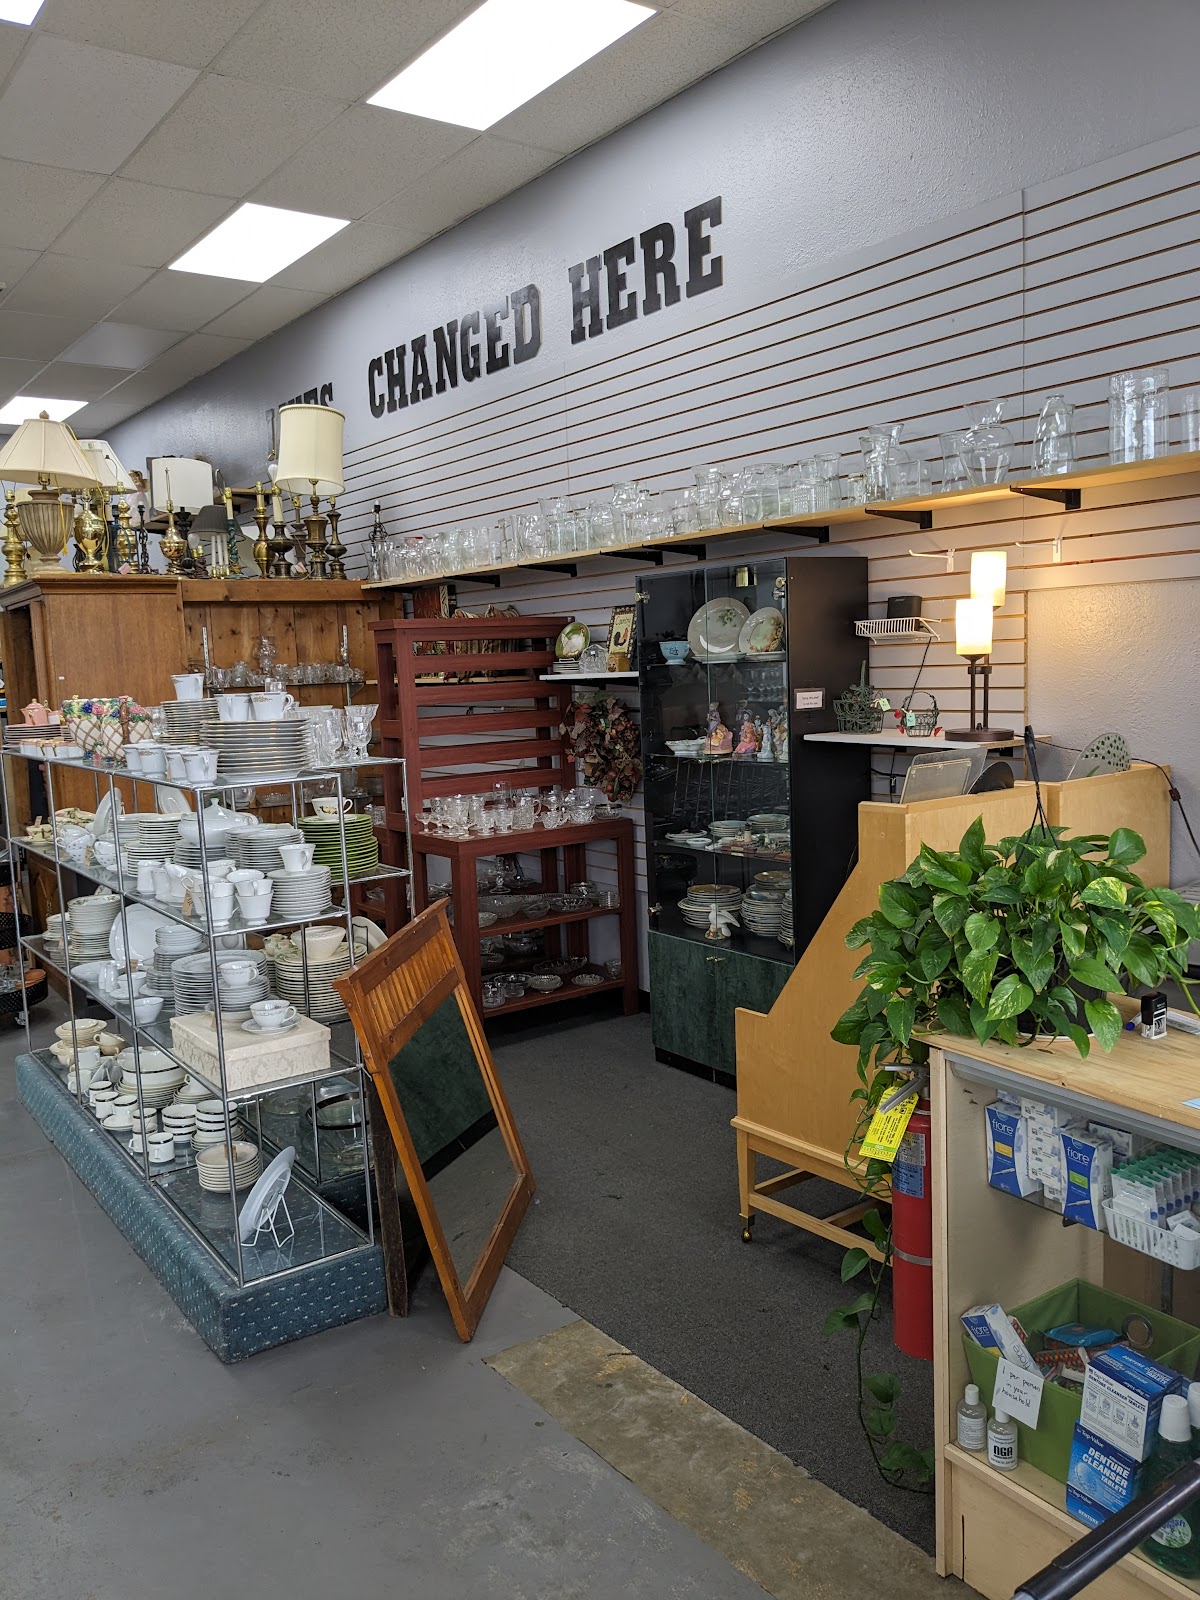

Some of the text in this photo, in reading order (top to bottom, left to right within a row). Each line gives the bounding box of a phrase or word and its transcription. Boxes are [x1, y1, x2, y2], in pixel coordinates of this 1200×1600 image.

[368, 195, 723, 418] CHANGED HERE
[992, 1119, 1014, 1135] fiore
[1067, 1146, 1090, 1164] fiore
[970, 1324, 990, 1335] fiore
[1009, 1371, 1020, 1380] per
[1022, 1379, 1041, 1392] person
[1013, 1386, 1029, 1395] your
[1001, 1386, 1031, 1408] household
[1106, 1386, 1127, 1401] CLEANSER
[1081, 1429, 1104, 1448] Top-Value
[1082, 1453, 1128, 1488] CLEANSER
[1088, 1446, 1130, 1479] DENTURE
[1100, 1474, 1127, 1496] TABLETS
